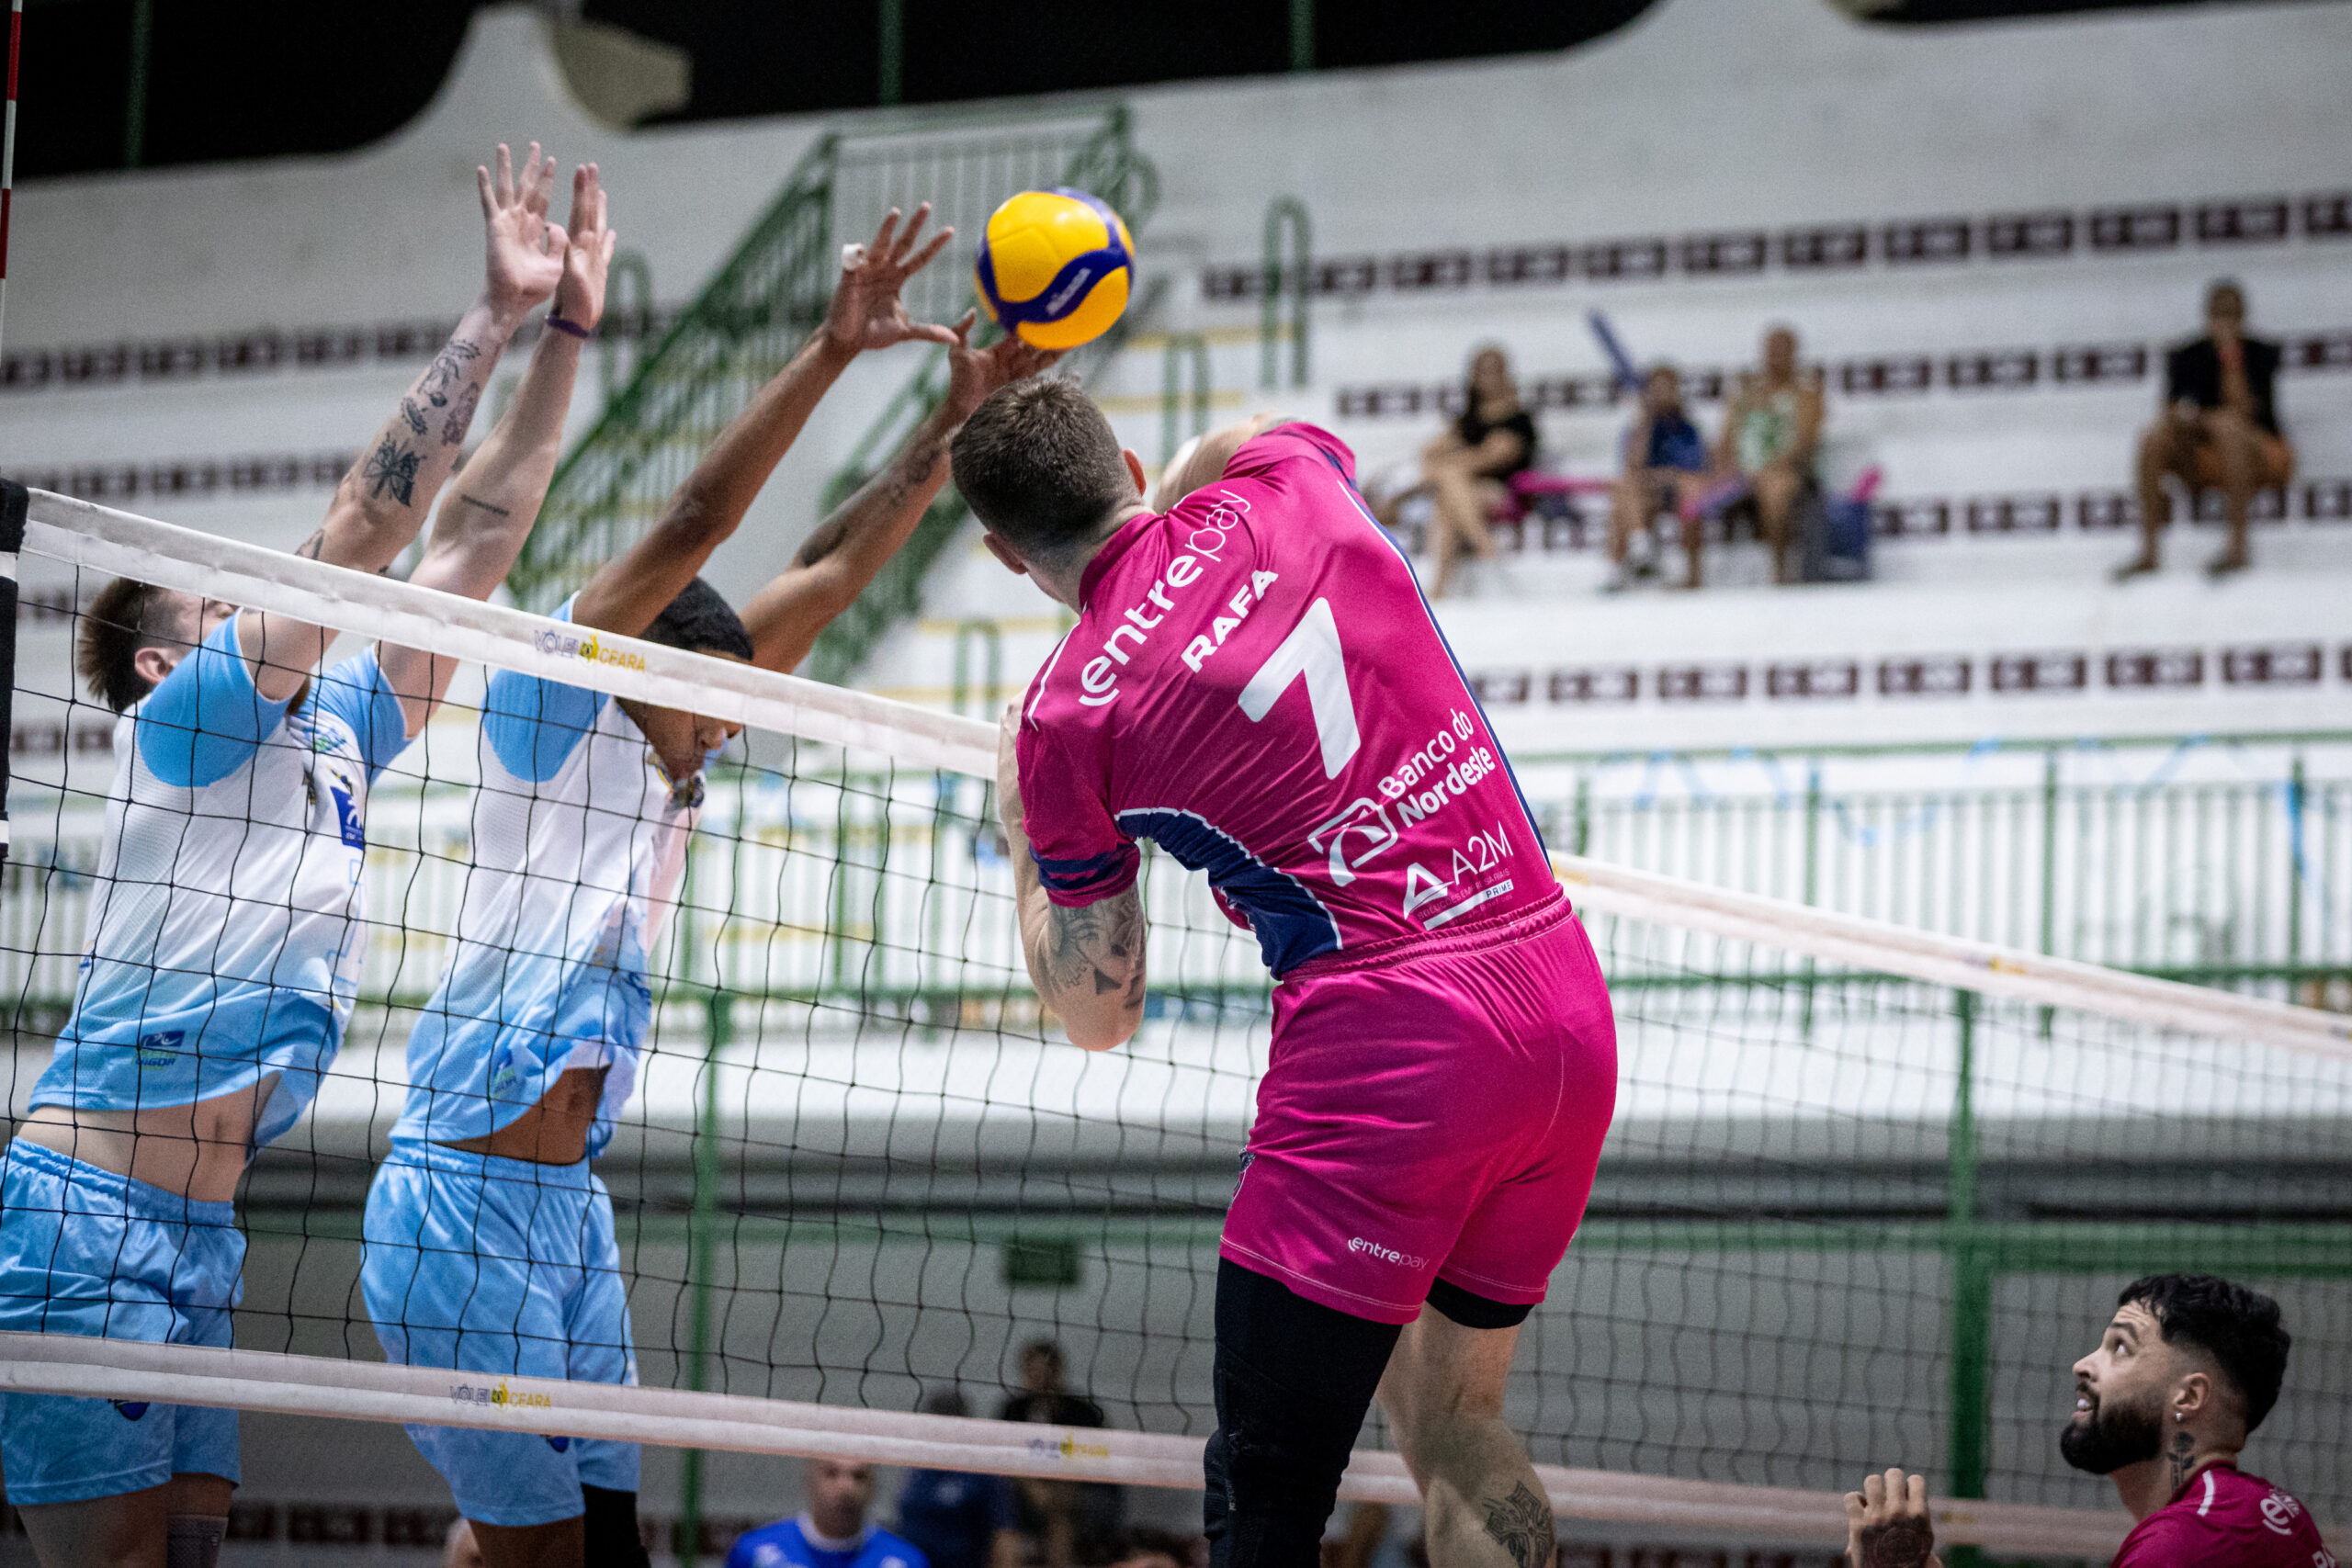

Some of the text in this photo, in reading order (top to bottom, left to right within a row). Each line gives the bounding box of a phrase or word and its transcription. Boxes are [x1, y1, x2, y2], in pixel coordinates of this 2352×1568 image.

[1080, 489, 1251, 699] entrepay
[1181, 570, 1279, 673] RAFA
[1238, 597, 1361, 780] 7
[1378, 707, 1474, 799] Banco do
[1396, 746, 1496, 828] Nordeste
[1453, 819, 1514, 886] A2M
[1486, 882, 1513, 898] PRIME
[1350, 1236, 1430, 1271] entrepay
